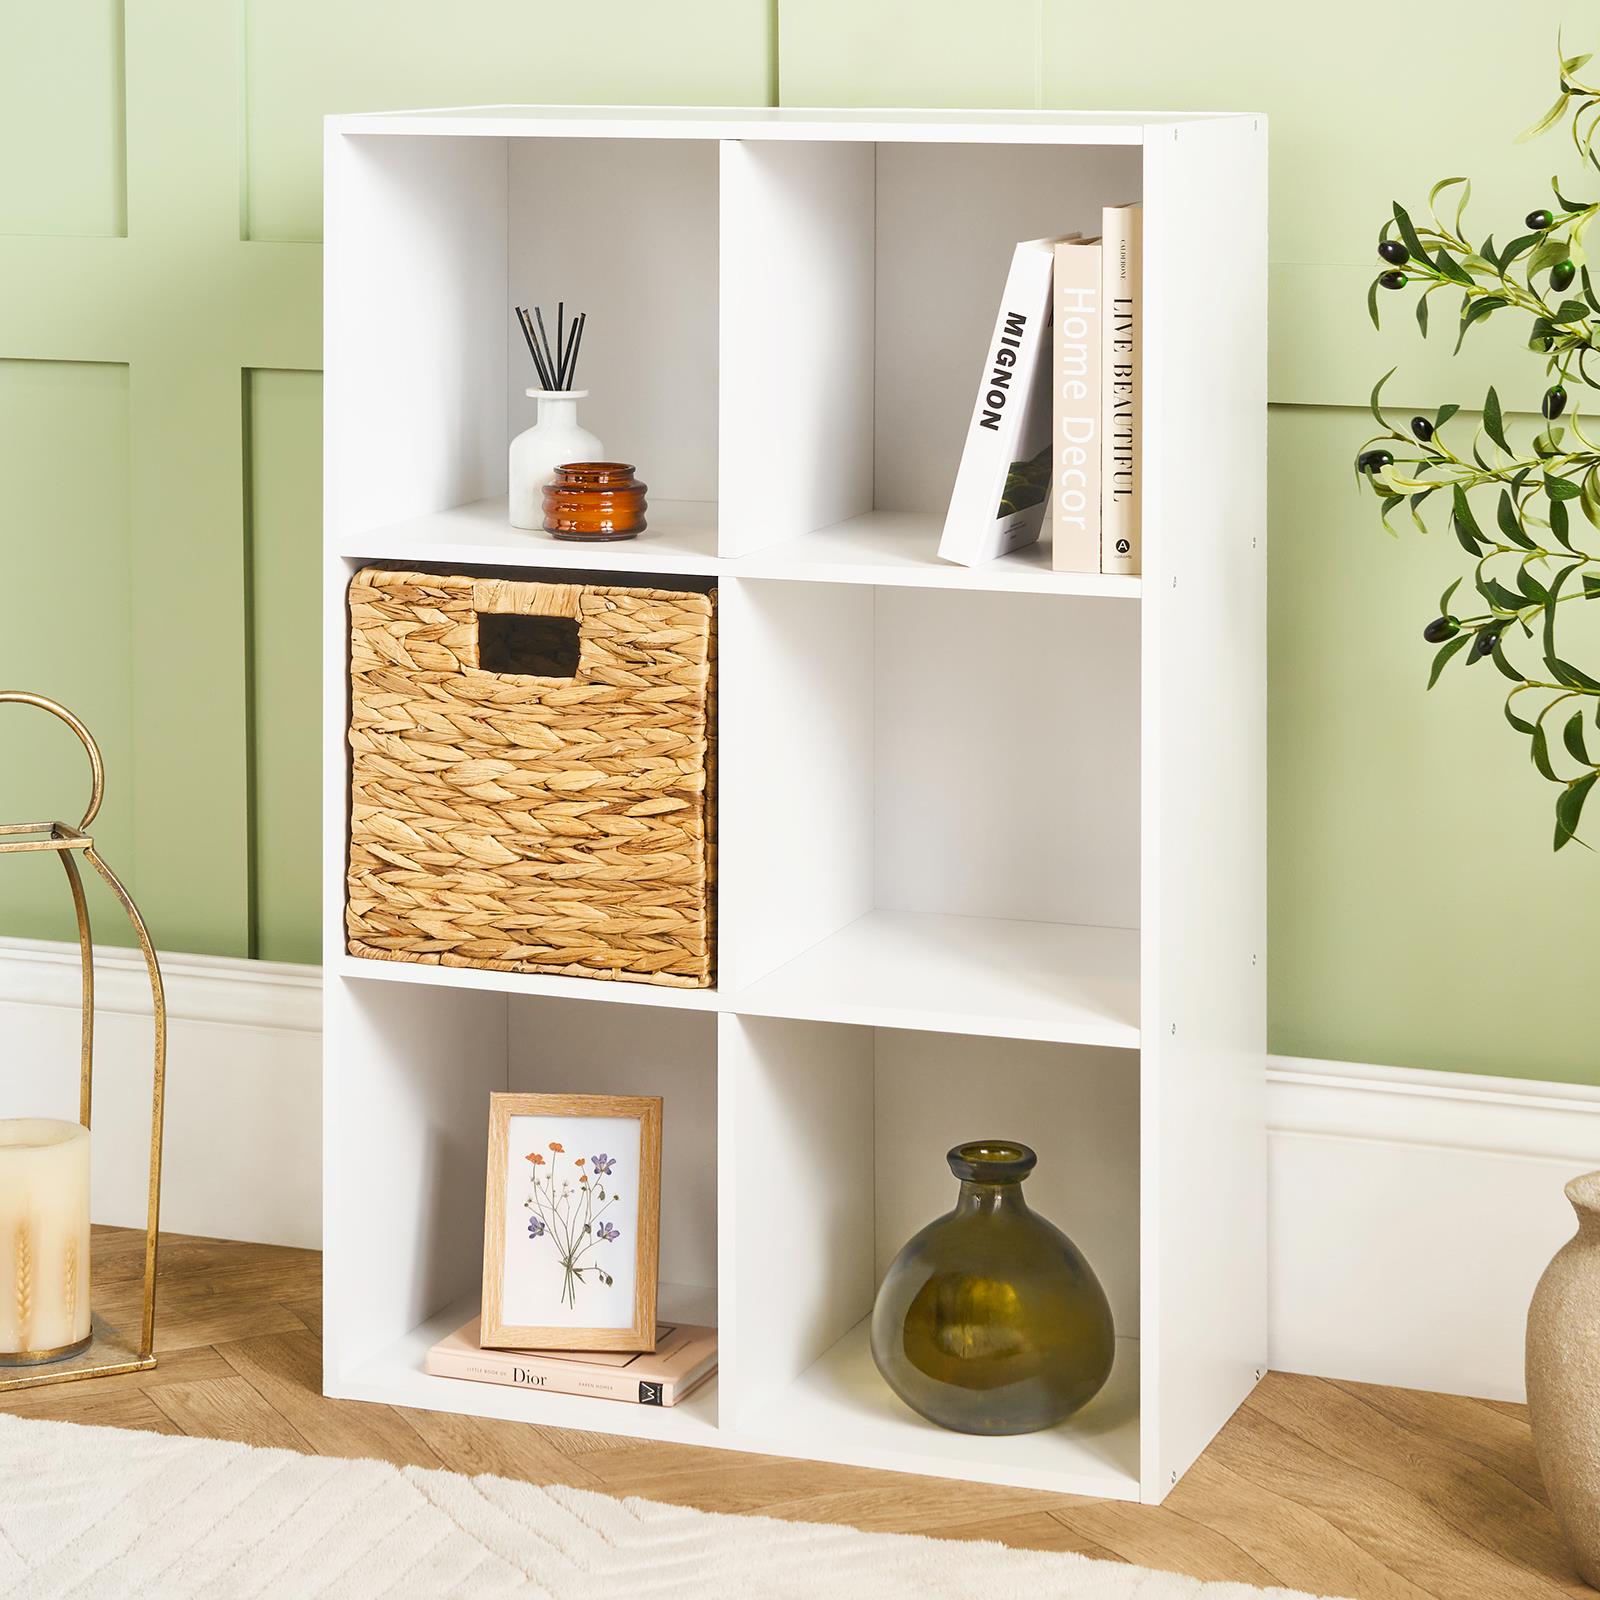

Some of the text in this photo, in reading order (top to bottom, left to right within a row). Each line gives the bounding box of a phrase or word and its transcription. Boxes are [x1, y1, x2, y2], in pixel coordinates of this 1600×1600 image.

[980, 312, 1027, 431] MIGNON
[1062, 288, 1096, 531] Home Decor
[1113, 298, 1133, 502] LIVE BEAUTIFUL
[513, 1367, 547, 1386] Dior
